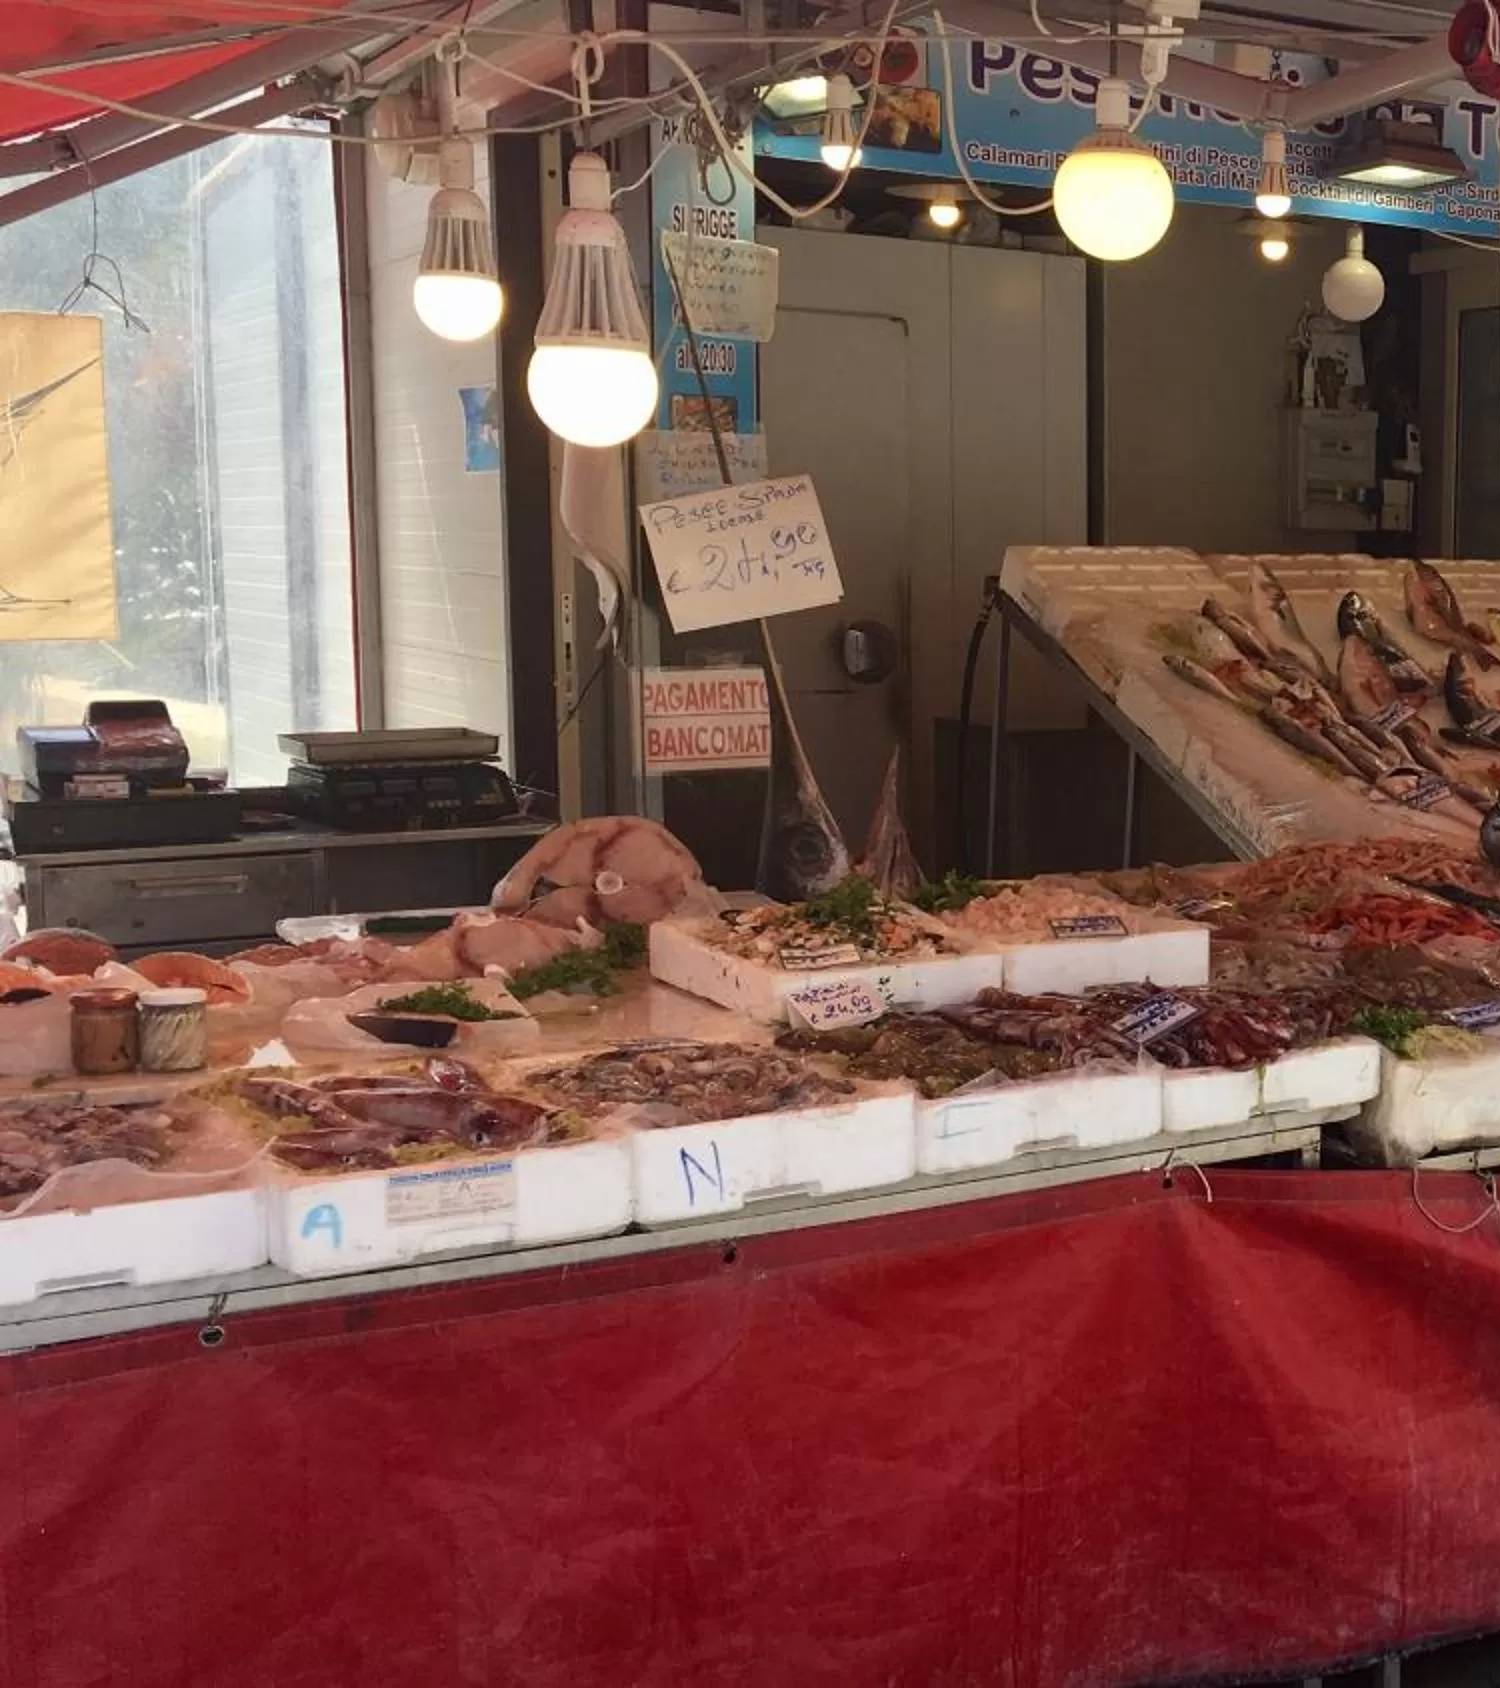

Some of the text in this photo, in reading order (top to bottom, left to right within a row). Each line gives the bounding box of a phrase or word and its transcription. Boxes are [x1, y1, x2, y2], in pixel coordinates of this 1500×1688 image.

[967, 143, 1049, 169] Calamari
[1467, 183, 1499, 200] Sard
[648, 724, 769, 757] BANCOMAT
[680, 1139, 724, 1207] N
[301, 1203, 342, 1249] A
